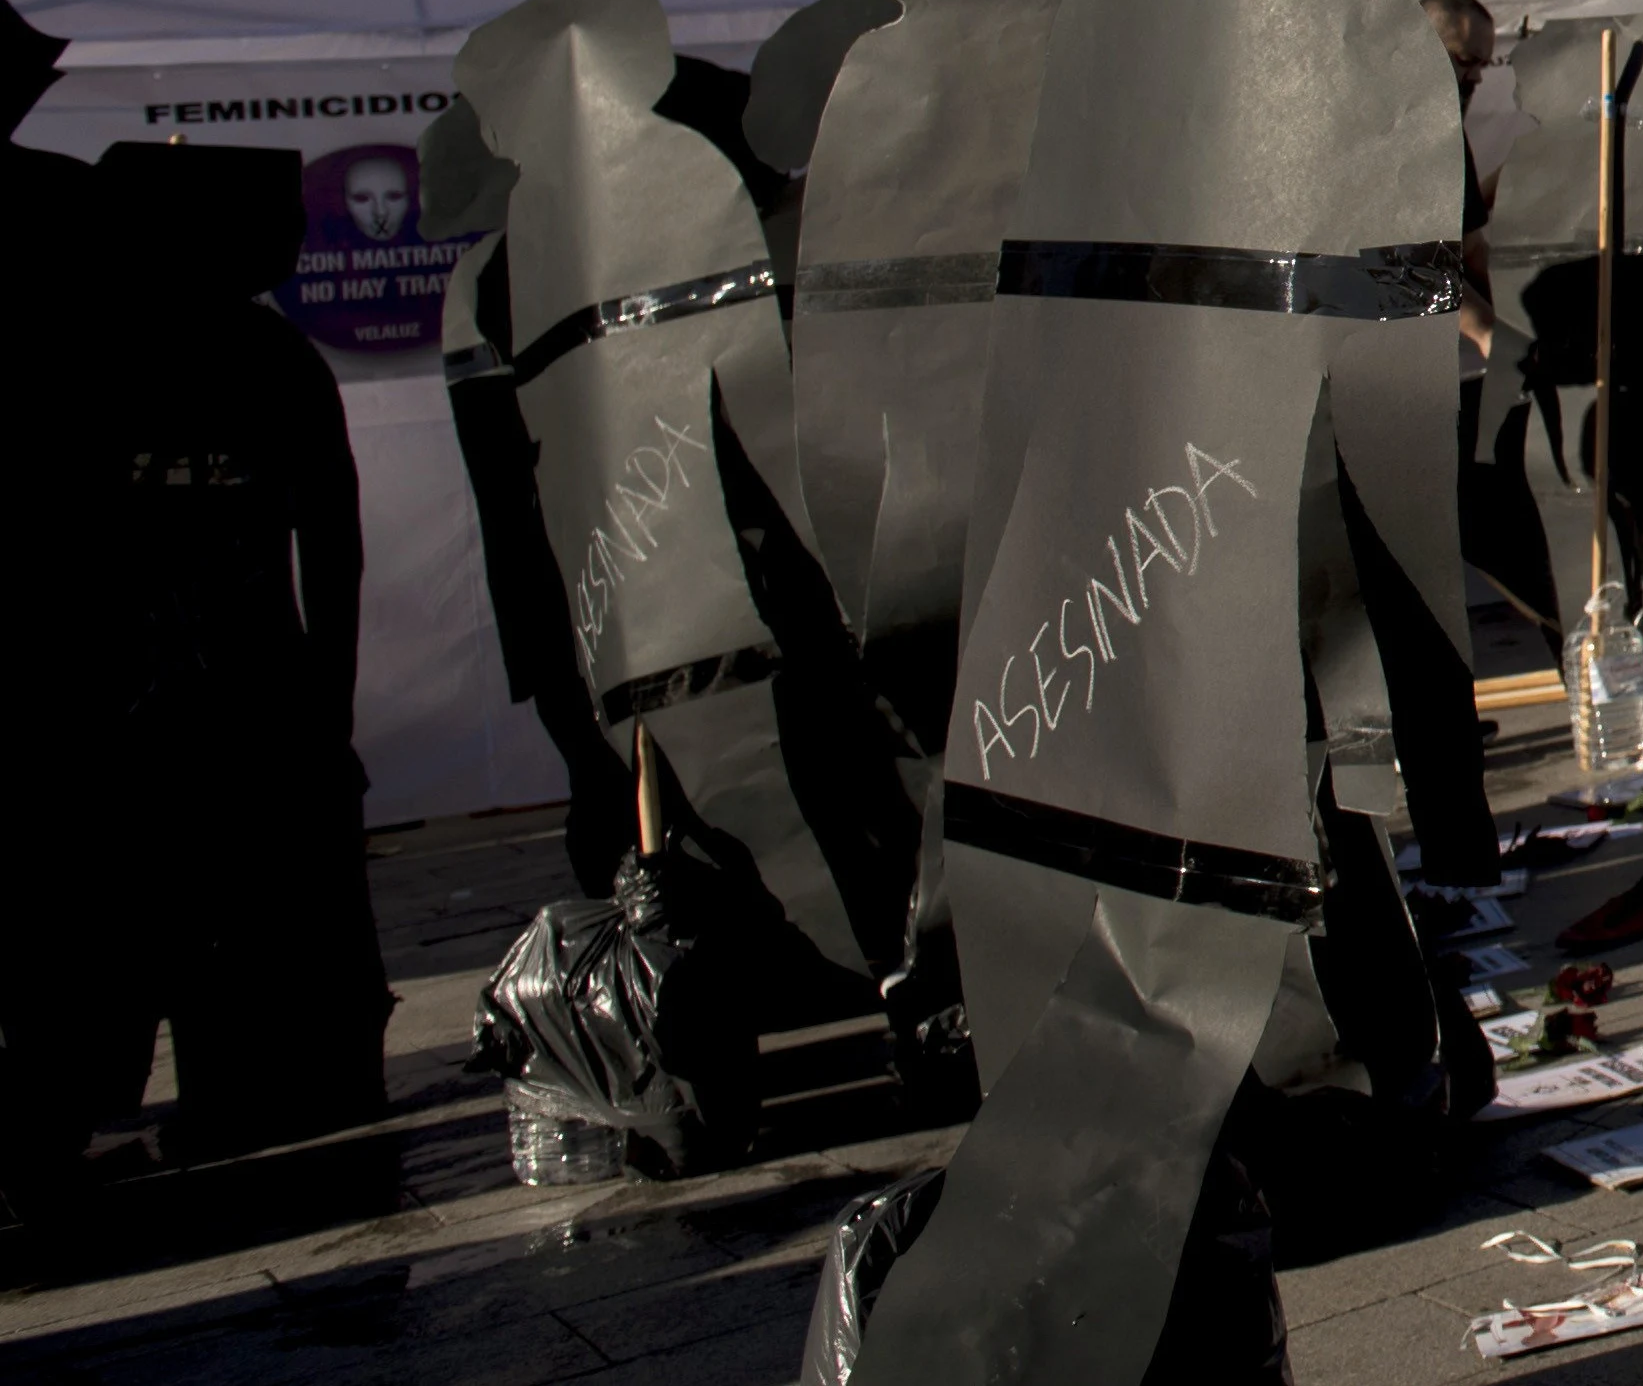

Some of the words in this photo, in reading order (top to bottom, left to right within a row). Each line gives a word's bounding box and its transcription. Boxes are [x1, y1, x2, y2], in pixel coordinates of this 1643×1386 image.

[146, 92, 462, 124] FEMINICIDIO
[296, 250, 346, 275] CON
[300, 279, 337, 305] NO
[342, 276, 388, 301] HAY
[577, 415, 707, 690] ASESINADA
[972, 442, 1257, 780] ASESINADA
